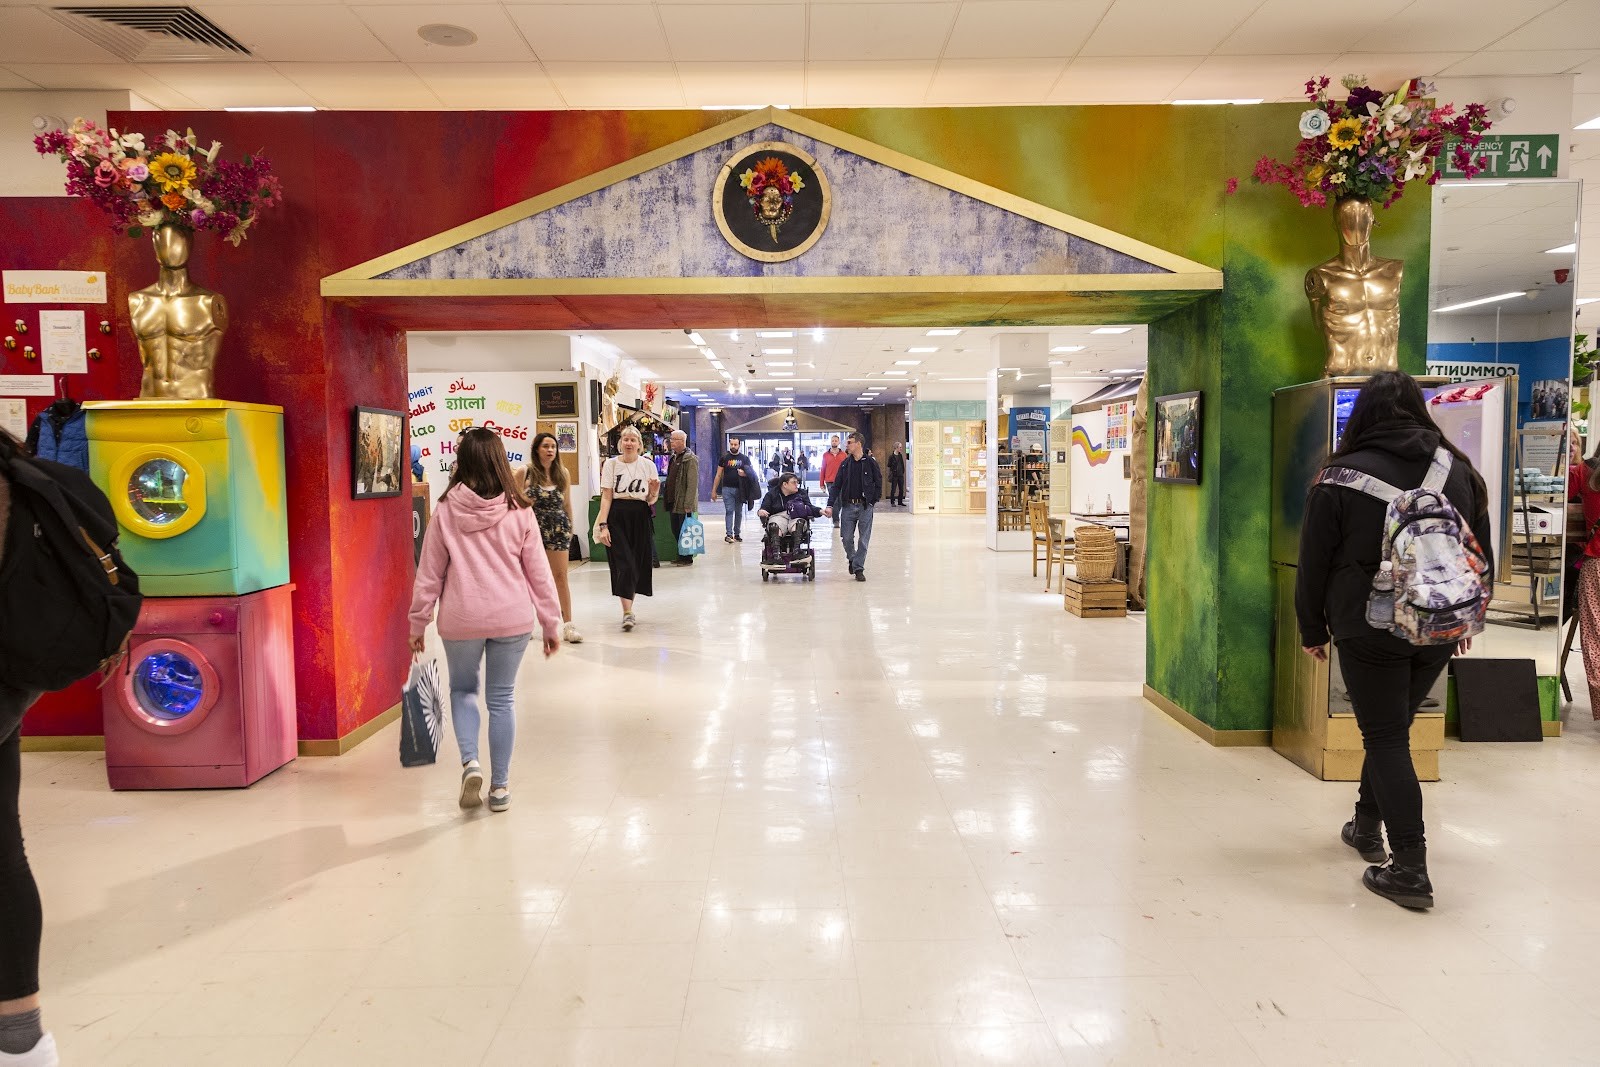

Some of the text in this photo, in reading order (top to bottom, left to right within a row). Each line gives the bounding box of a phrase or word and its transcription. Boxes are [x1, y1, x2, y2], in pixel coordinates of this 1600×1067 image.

[8, 284, 104, 297] Baby Bank Network
[408, 386, 433, 402] ривіт
[410, 424, 436, 438] iao
